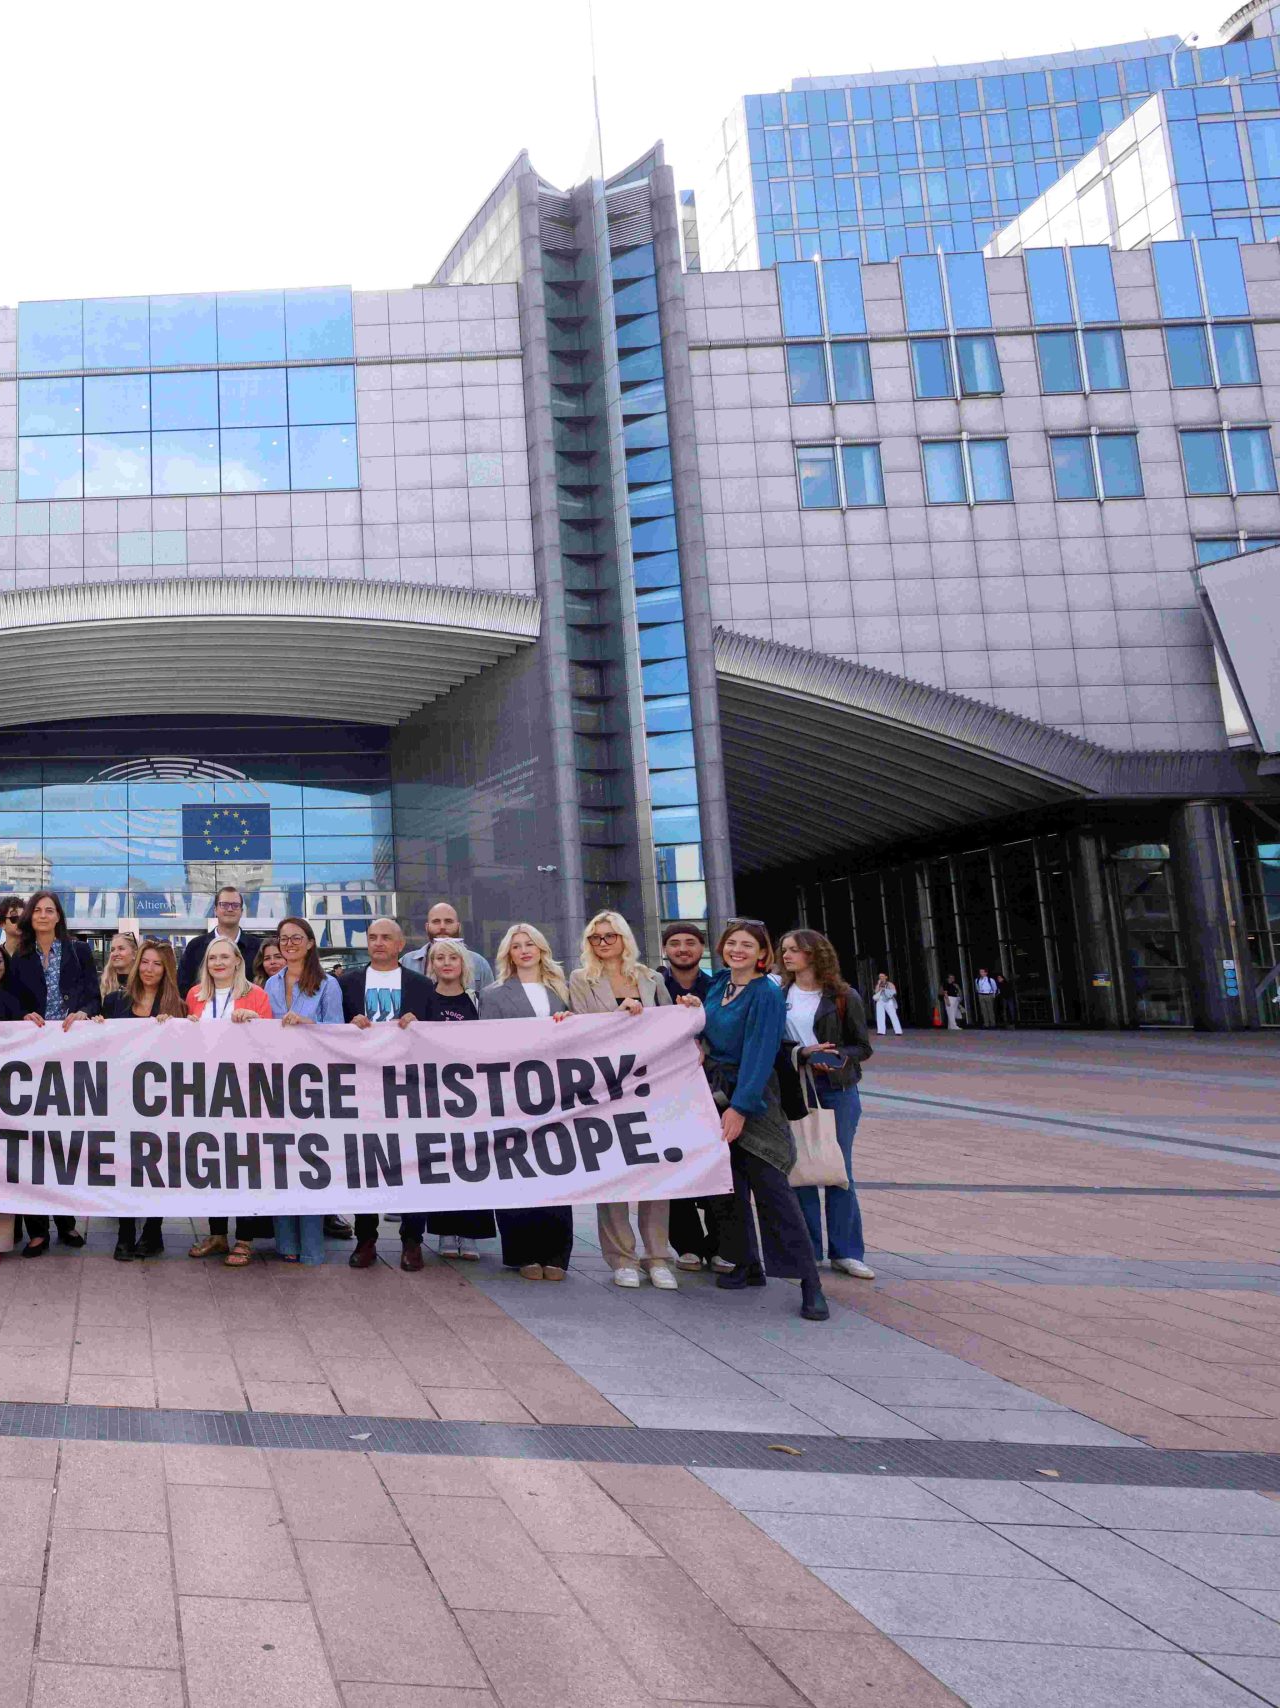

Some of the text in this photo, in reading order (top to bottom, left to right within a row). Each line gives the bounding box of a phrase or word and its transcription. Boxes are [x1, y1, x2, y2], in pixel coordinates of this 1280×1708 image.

[445, 1011, 464, 1021] VOICE
[132, 1061, 359, 1120] CHANGE
[382, 1054, 651, 1119] HISTORY:
[130, 1131, 332, 1190] RIGHTS
[343, 1133, 404, 1189] IN
[415, 1111, 684, 1185] EUROPE.
